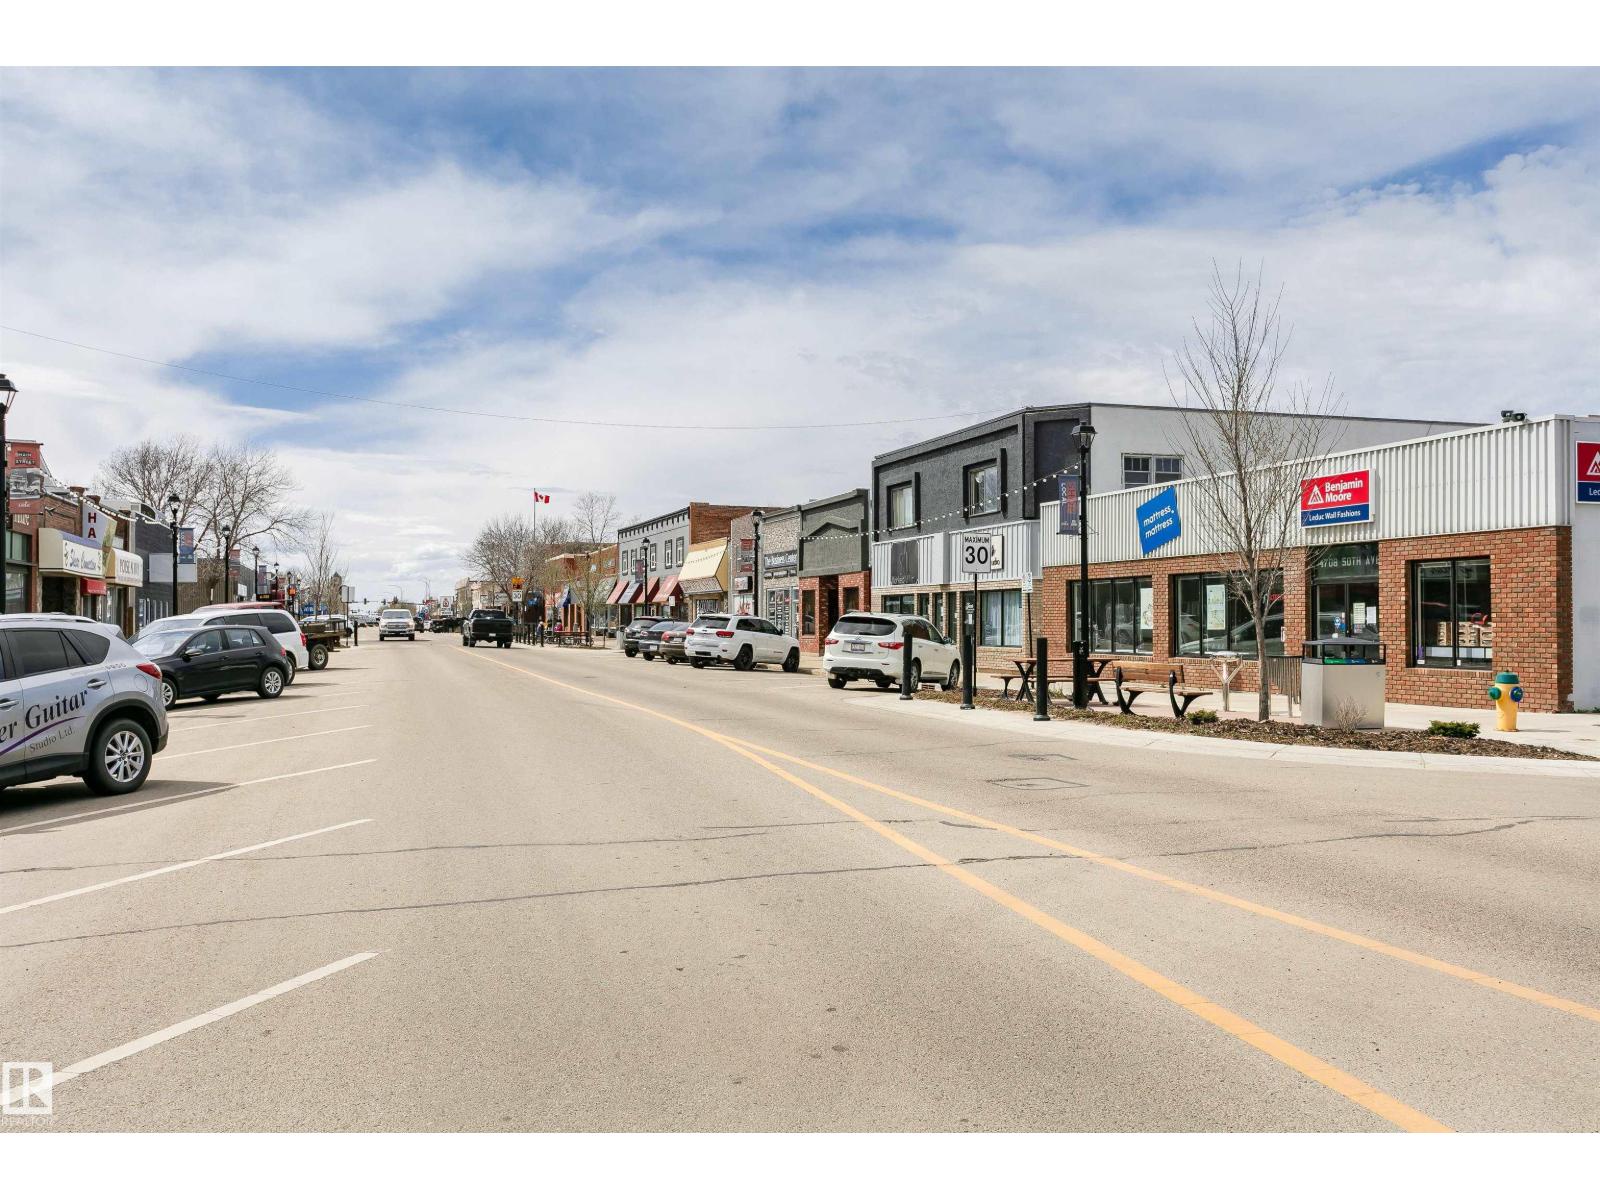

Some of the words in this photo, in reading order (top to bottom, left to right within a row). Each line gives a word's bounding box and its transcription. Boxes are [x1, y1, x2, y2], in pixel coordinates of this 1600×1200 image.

[1325, 478, 1363, 492] Benjamin
[1325, 492, 1352, 503] Moore
[1309, 512, 1324, 521] Leduc
[1325, 511, 1337, 519] Wall
[1337, 510, 1361, 518] Fashions
[1145, 517, 1173, 539] mattress
[965, 546, 988, 564] 30
[1341, 556, 1362, 567] 50TH
[25, 689, 88, 729] Guitar
[29, 735, 57, 752] Studio
